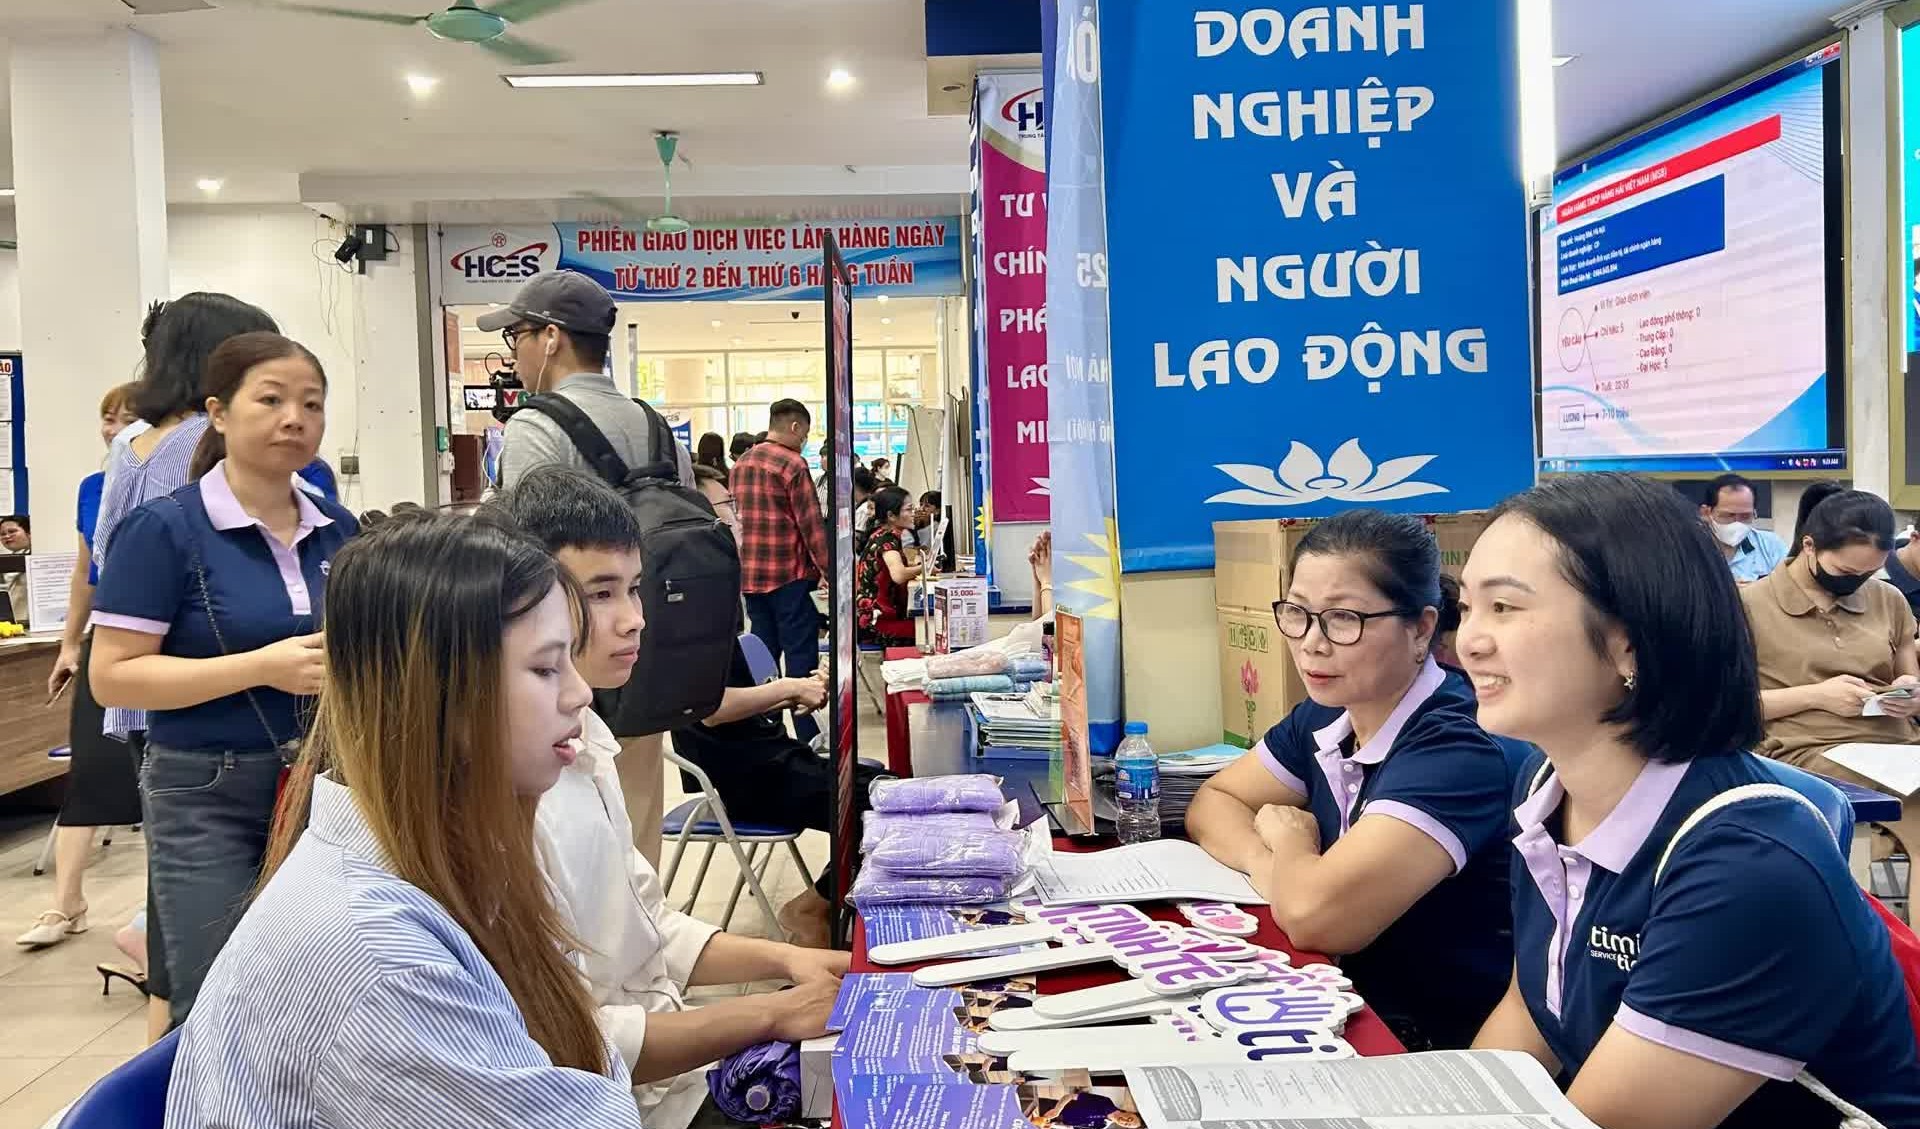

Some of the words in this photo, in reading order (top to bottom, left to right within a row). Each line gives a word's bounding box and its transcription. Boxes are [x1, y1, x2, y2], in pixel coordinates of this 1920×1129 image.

[1193, 4, 1425, 59] DOANH
[1193, 76, 1435, 149] NGHIỆP
[1000, 193, 1034, 217] TƯ
[1271, 160, 1357, 223] VÀ
[578, 226, 635, 252] PHIÊN
[643, 231, 688, 251] GIAO
[693, 229, 738, 254] DỊCH
[744, 226, 786, 254] VIỆC
[838, 222, 889, 248] HÀNG
[896, 220, 945, 246] NGÀY
[464, 255, 540, 278] HCES
[615, 263, 639, 290] TỪ
[643, 262, 682, 289] THỨ
[686, 266, 697, 288] 2
[703, 260, 742, 287] ĐẾN
[748, 262, 785, 287] THỨ
[790, 266, 801, 287] 6
[864, 256, 913, 284] TUẦN
[1216, 241, 1421, 303] NGƯỜI
[1154, 337, 1280, 391] LAO
[1302, 322, 1488, 393] ĐỘNG
[1017, 420, 1049, 443] MI
